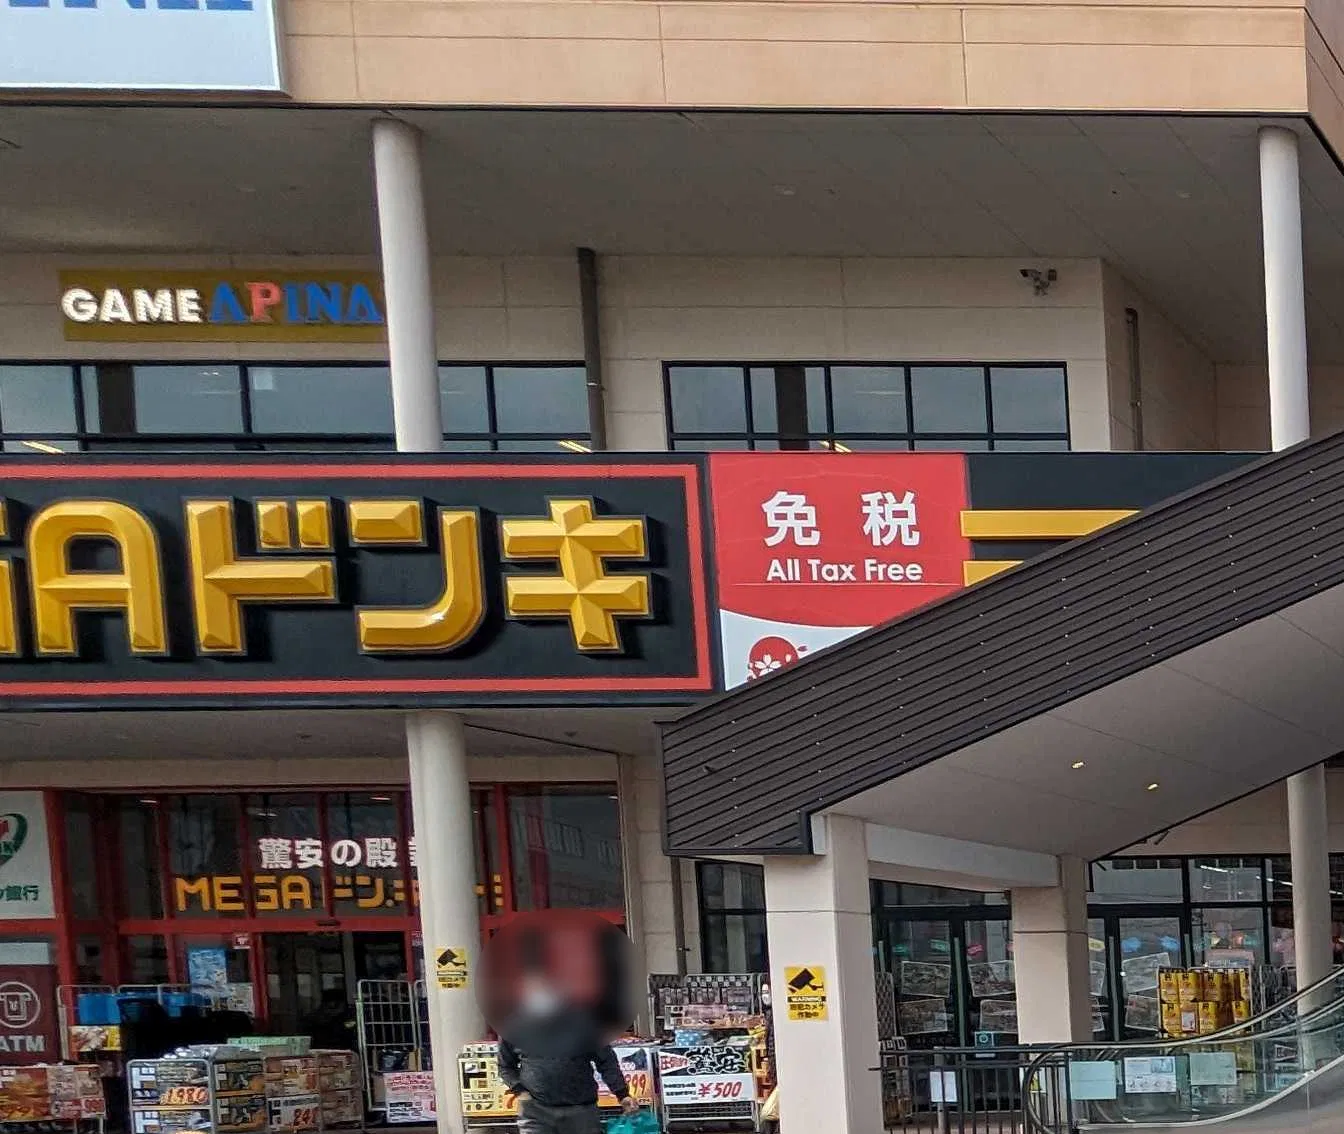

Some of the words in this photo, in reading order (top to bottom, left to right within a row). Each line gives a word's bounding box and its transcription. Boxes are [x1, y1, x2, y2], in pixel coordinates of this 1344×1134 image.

[61, 287, 205, 323] GAME
[209, 281, 384, 324] APINA
[761, 490, 921, 548] 免税
[0, 495, 654, 656] Aドンキ
[766, 559, 801, 582] All
[807, 559, 856, 582] Tax
[865, 559, 924, 582] Free
[258, 837, 418, 869] 驚安の殿
[0, 884, 40, 902] 銀行
[0, 1034, 45, 1053] ATM
